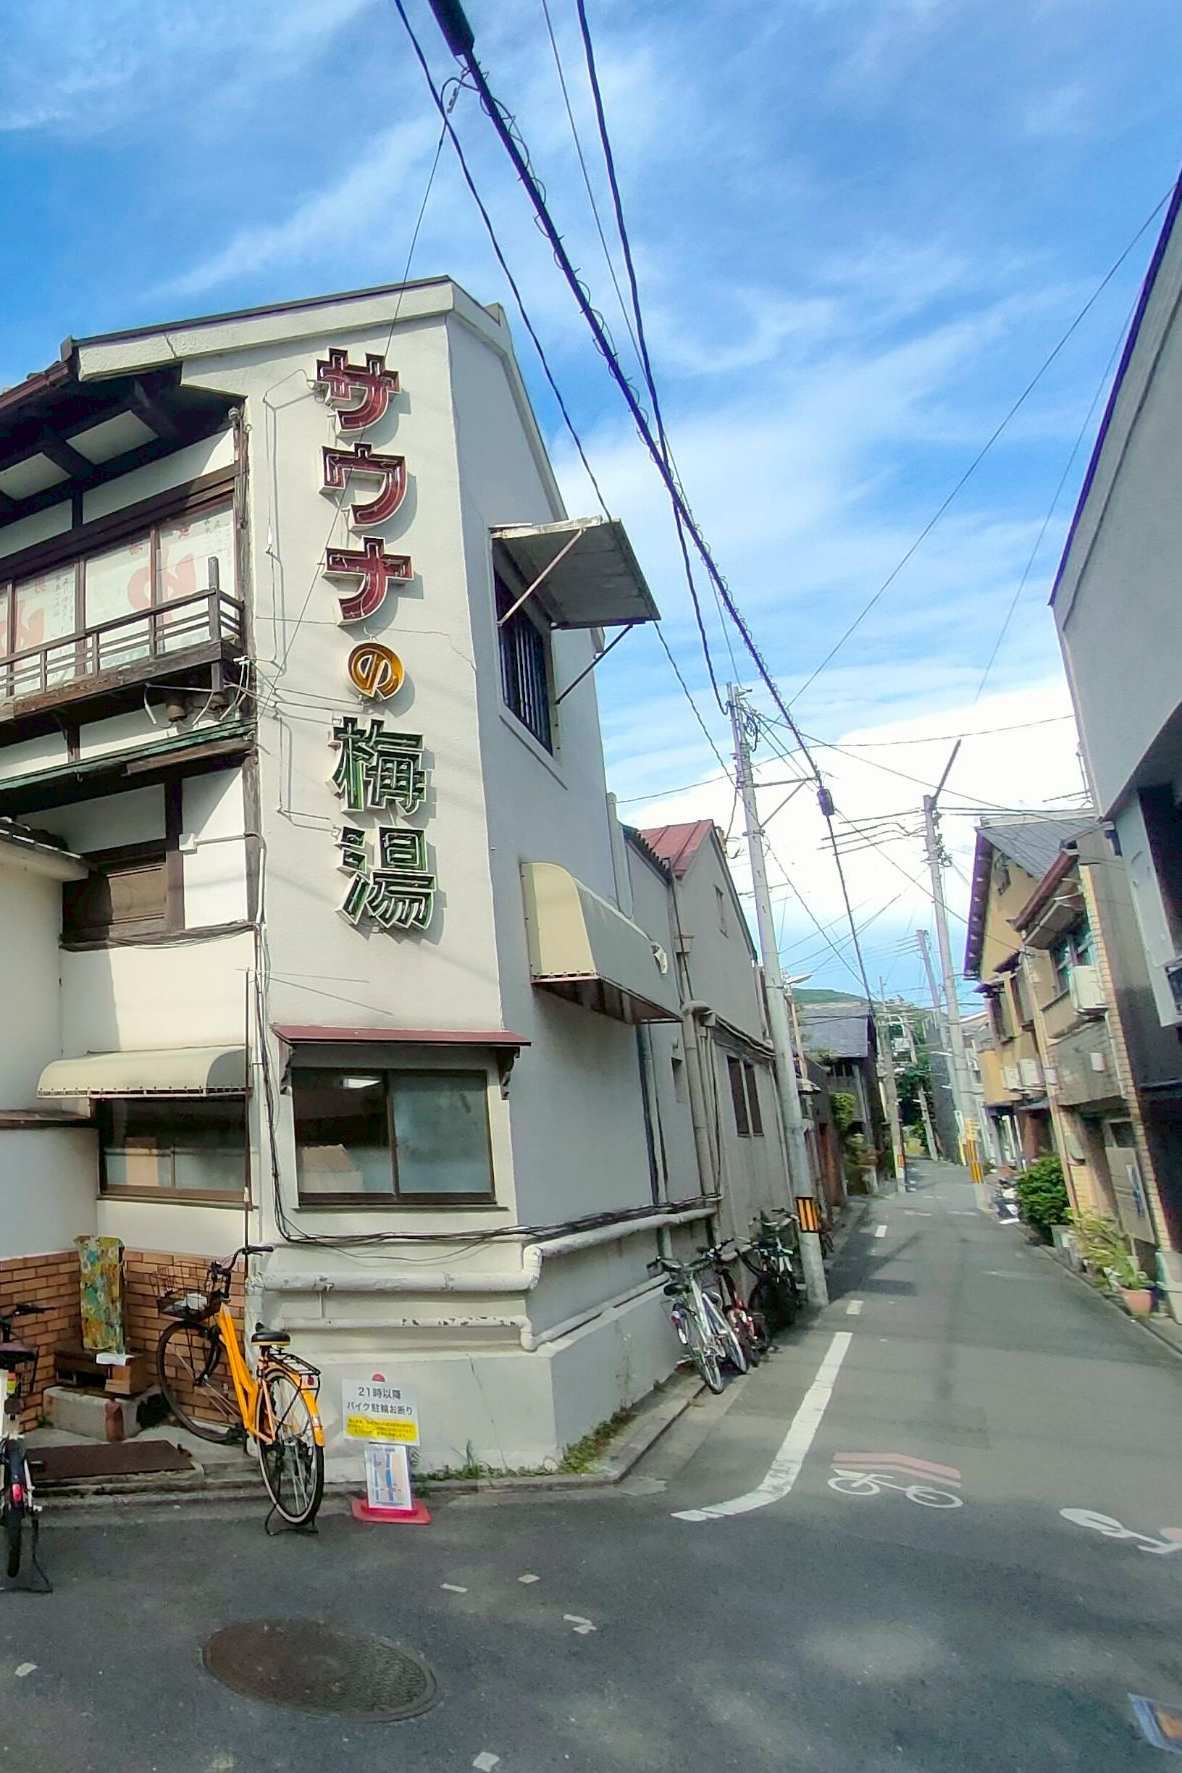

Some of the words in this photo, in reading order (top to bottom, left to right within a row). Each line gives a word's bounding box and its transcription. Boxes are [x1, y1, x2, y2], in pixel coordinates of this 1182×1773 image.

[316, 347, 436, 930] サウナの梅湯
[358, 1386, 401, 1400] 21時以降
[347, 1401, 413, 1416] バイク駐輪お断り
